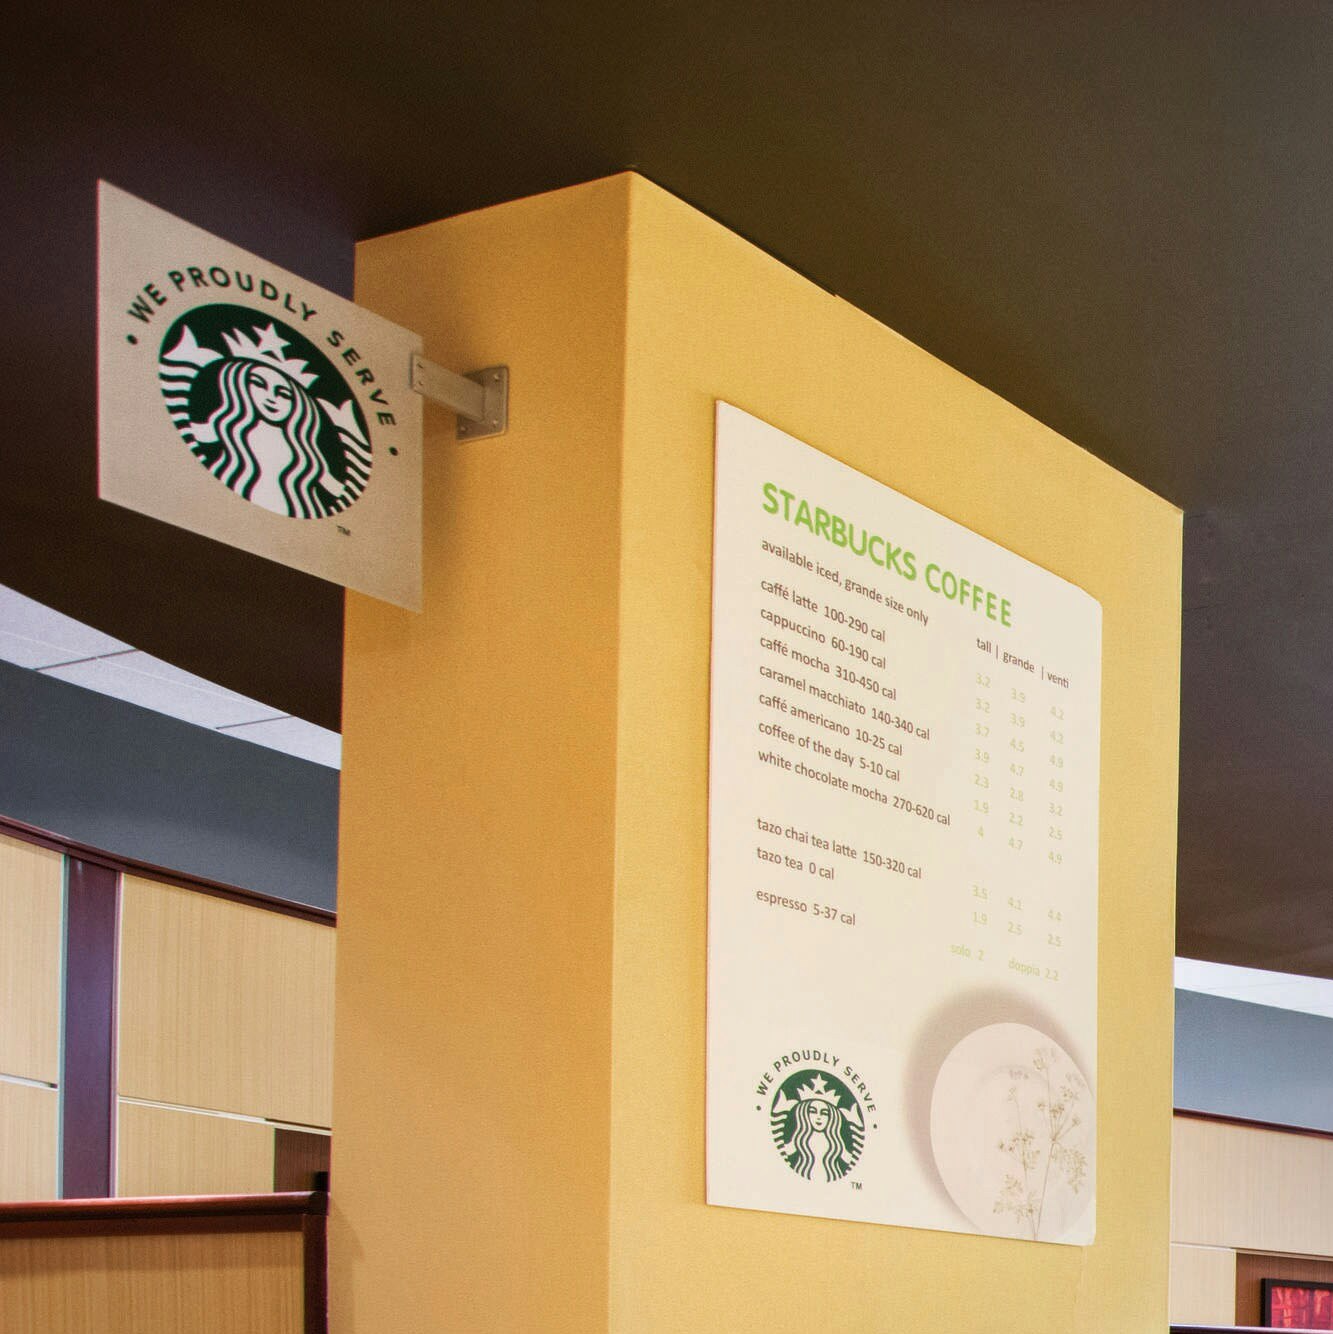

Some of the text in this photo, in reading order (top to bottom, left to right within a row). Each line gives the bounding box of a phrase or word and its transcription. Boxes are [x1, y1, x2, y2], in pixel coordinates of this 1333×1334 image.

[127, 266, 396, 427] WE PROUDLY SERVE
[762, 482, 1011, 628] STARBUCKS COFFEE
[762, 540, 928, 627] available iced, grande size only
[761, 580, 886, 642] caffé latte 100-290 cal
[761, 608, 886, 669] cappuccino 60-190 cal
[760, 636, 897, 700] caffé mocha 310-450 cal
[976, 637, 992, 654] tall
[1003, 651, 1035, 673] grande
[1047, 672, 1069, 688] venti
[759, 693, 903, 756] caffé americano 10-25 cal
[760, 665, 930, 740] caramel macchiato 140-340 cal
[759, 722, 900, 782] coffee of the day 5-10 cal
[758, 750, 951, 826] white chocolate mocha 270-620 cal
[756, 846, 835, 880] tazo tea 0 cal
[757, 817, 922, 879] tazo chai tea latte 150-320 cal
[756, 889, 856, 926] espresso 5-37 cal
[757, 1050, 876, 1113] WE PROUDLY SERVE
